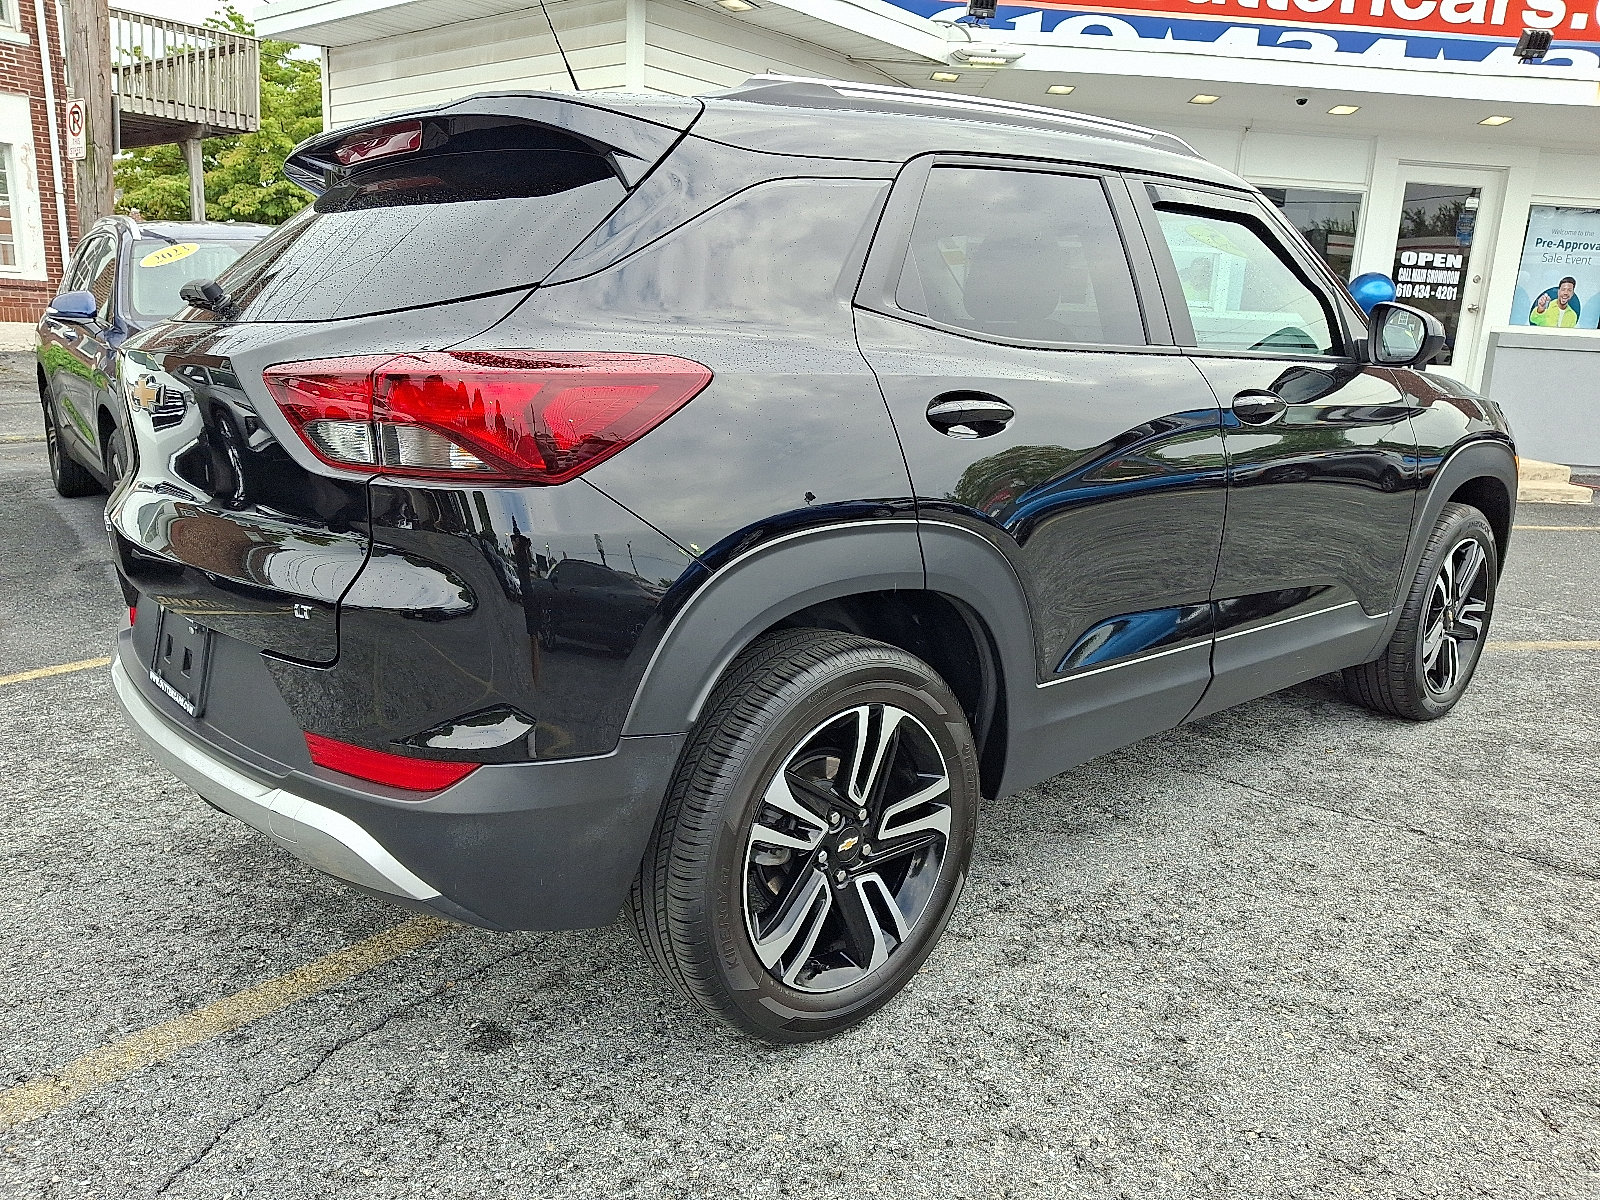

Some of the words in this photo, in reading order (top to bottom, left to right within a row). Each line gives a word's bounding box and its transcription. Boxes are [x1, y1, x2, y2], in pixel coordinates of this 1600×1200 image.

[1401, 251, 1463, 269] OPEN
[1541, 252, 1563, 264] Sale
[1565, 253, 1593, 266] Event
[294, 603, 313, 620] LT
